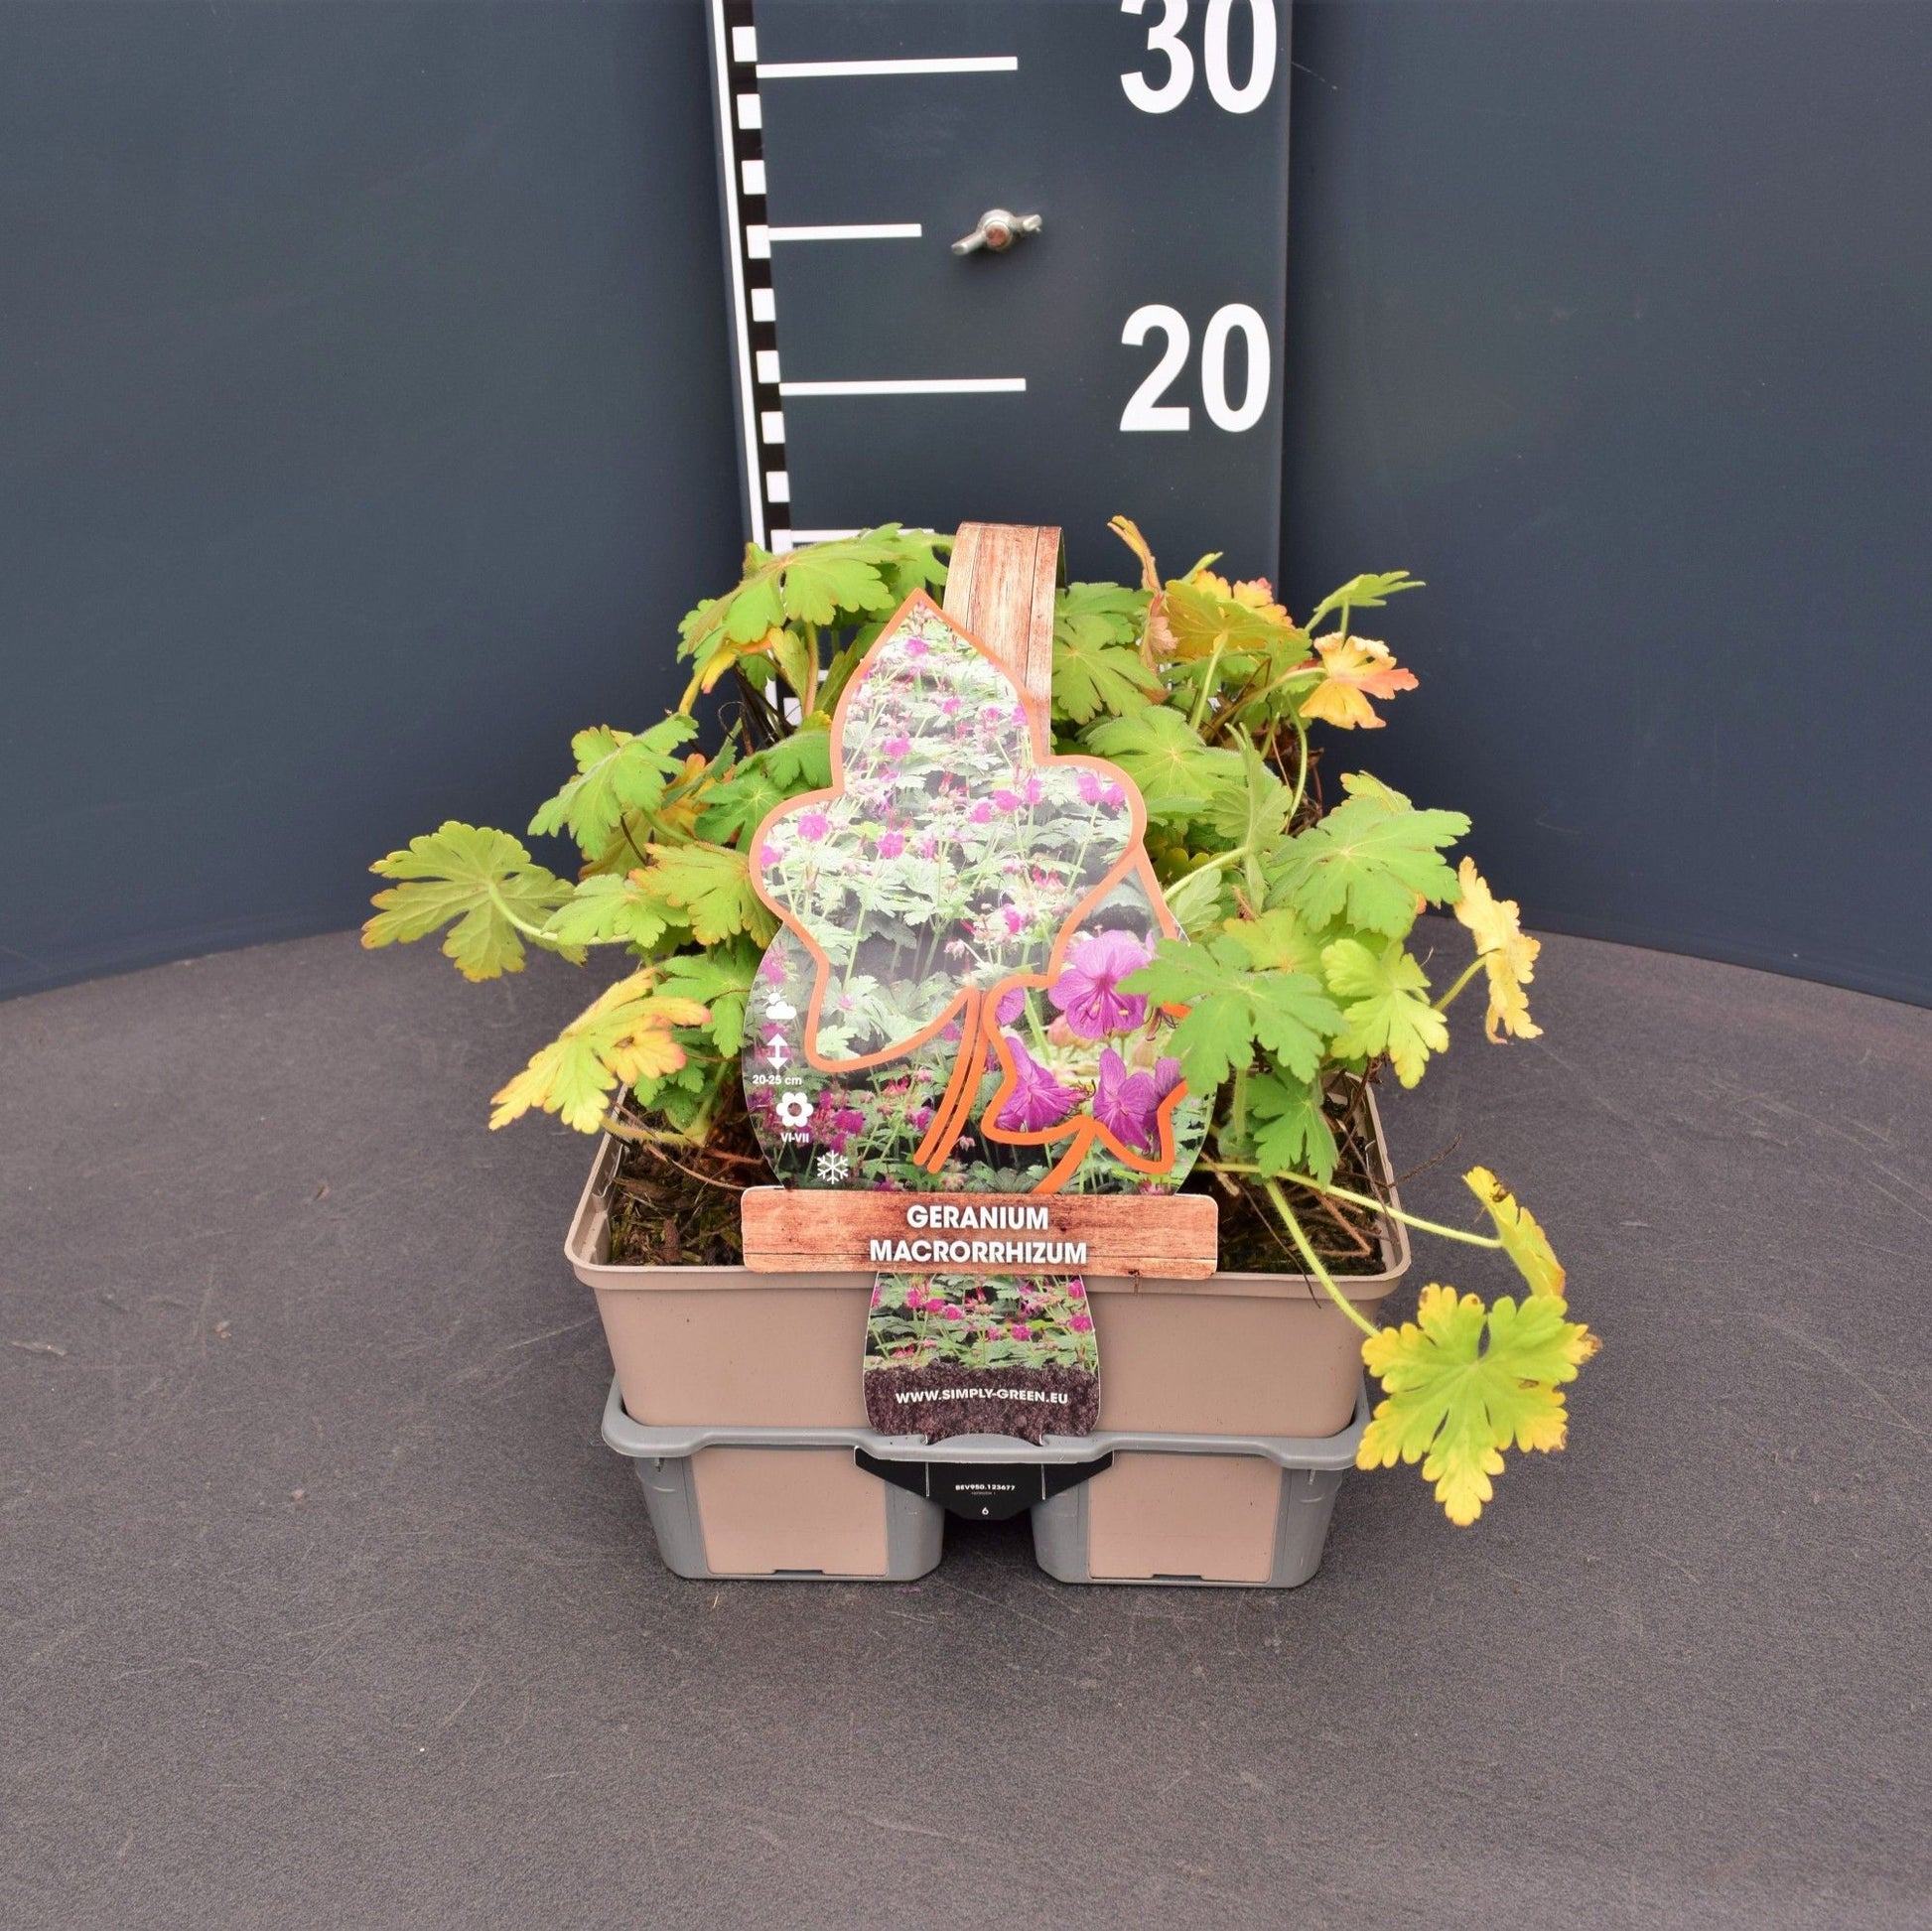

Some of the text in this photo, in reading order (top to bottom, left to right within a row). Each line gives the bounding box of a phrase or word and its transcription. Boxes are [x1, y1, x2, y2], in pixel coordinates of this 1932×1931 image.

[1120, 0, 1277, 114] 30
[1119, 303, 1271, 433] 20
[752, 1074, 802, 1085] 20-25 cm
[780, 1132, 809, 1143] VI-VII
[906, 1204, 1048, 1230] GERANIUM
[870, 1239, 1087, 1264] MACRORRHIZUM
[896, 1388, 1068, 1405] WWW.SIMPLY-GREEN.EU
[981, 1507, 989, 1516] 6
